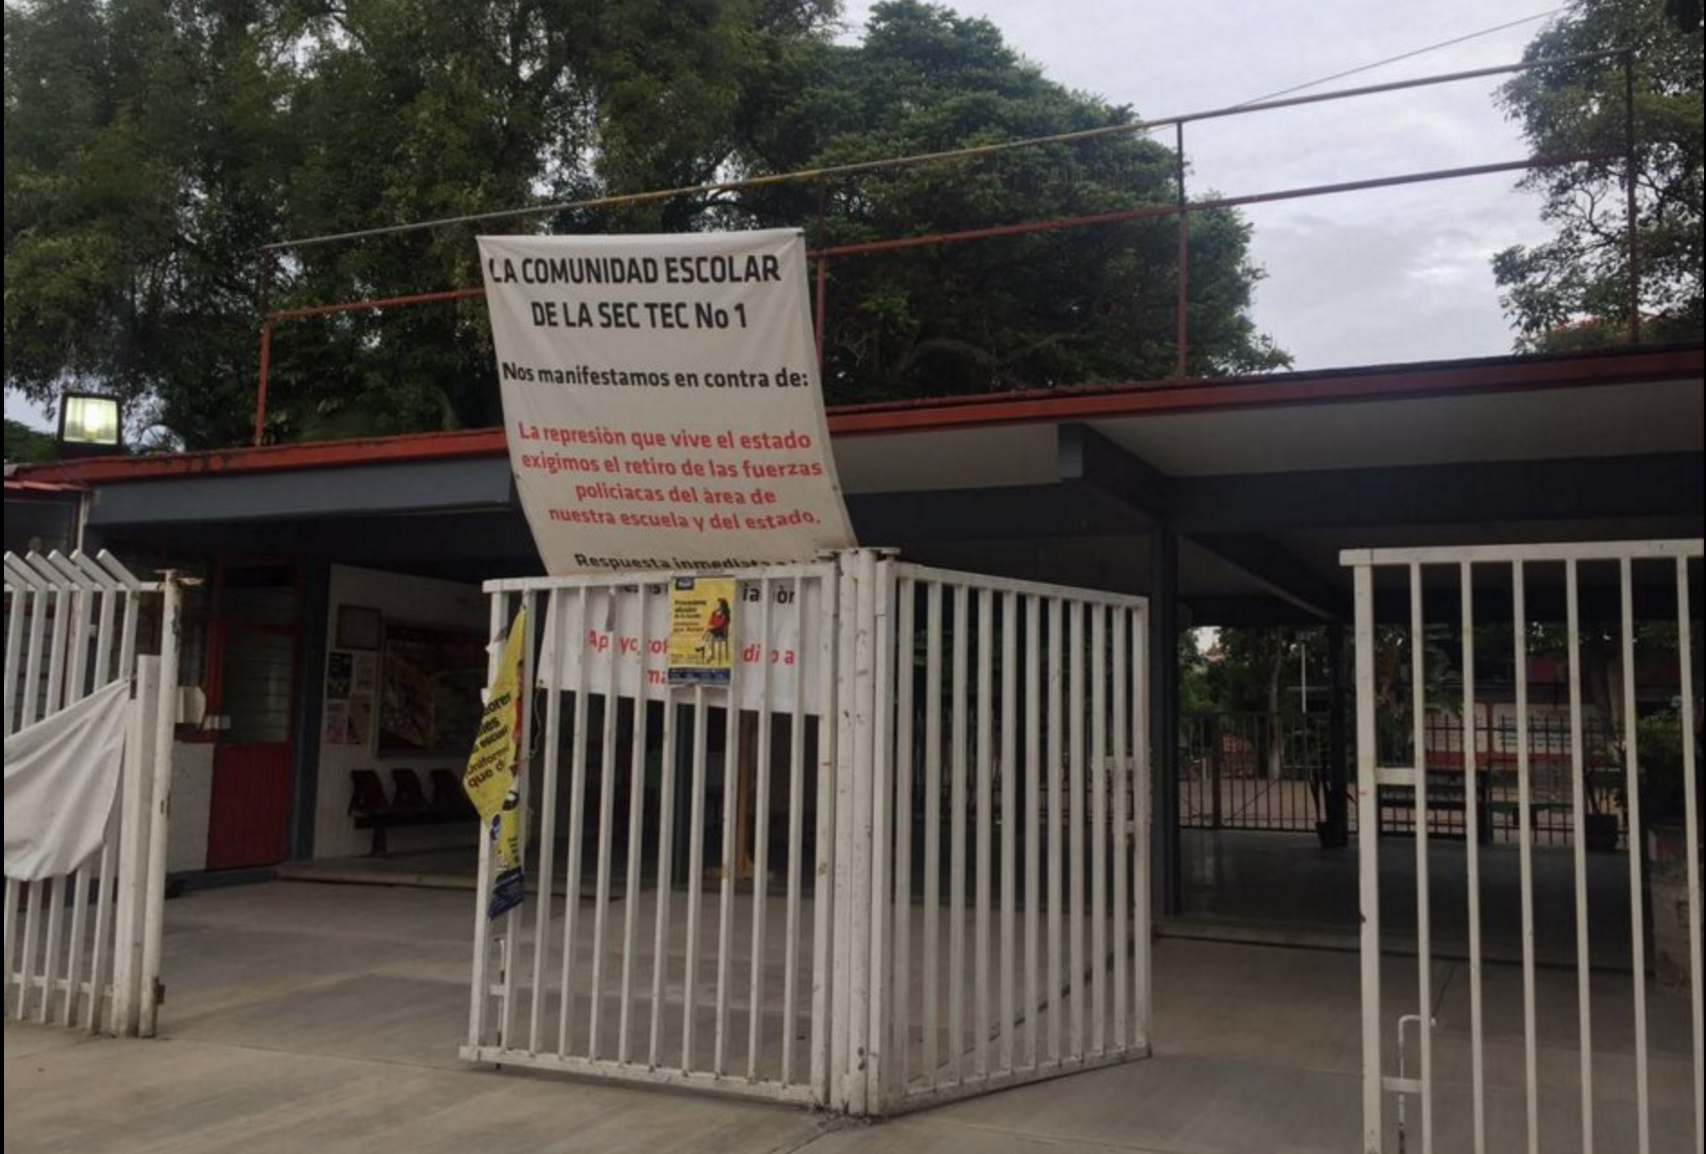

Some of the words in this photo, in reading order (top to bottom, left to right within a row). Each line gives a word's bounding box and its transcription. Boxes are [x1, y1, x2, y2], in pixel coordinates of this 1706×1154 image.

[489, 257, 518, 283] LA
[522, 257, 659, 284] COMUNIDAD
[664, 254, 781, 283] ESCOLAR
[531, 302, 558, 327] DE
[563, 302, 593, 328] LA
[598, 302, 640, 329] SEC
[644, 302, 689, 329] TEC
[695, 302, 729, 329] No
[734, 303, 747, 328] 1
[502, 362, 534, 382] Nos
[538, 365, 669, 387] manifestamos
[675, 372, 699, 387] en
[704, 369, 769, 388] contra
[775, 367, 809, 387] de:
[518, 421, 539, 440] La
[631, 431, 666, 449] que
[671, 429, 712, 447] vive
[717, 430, 735, 449] el
[740, 430, 812, 449] estado
[522, 451, 599, 474] exigimos
[604, 455, 620, 473] el
[625, 457, 676, 475] retiro
[682, 459, 705, 476] de
[709, 459, 738, 477] las
[742, 460, 823, 478] fuerzas
[575, 482, 664, 501] policiacas
[669, 485, 698, 503] del
[751, 488, 777, 504] de
[549, 508, 616, 525] nuestra
[620, 511, 688, 528] escuela
[693, 516, 705, 532] y
[709, 513, 740, 529] del
[745, 509, 821, 529] estado.
[574, 553, 671, 570] Respuesta
[467, 767, 494, 788] que
